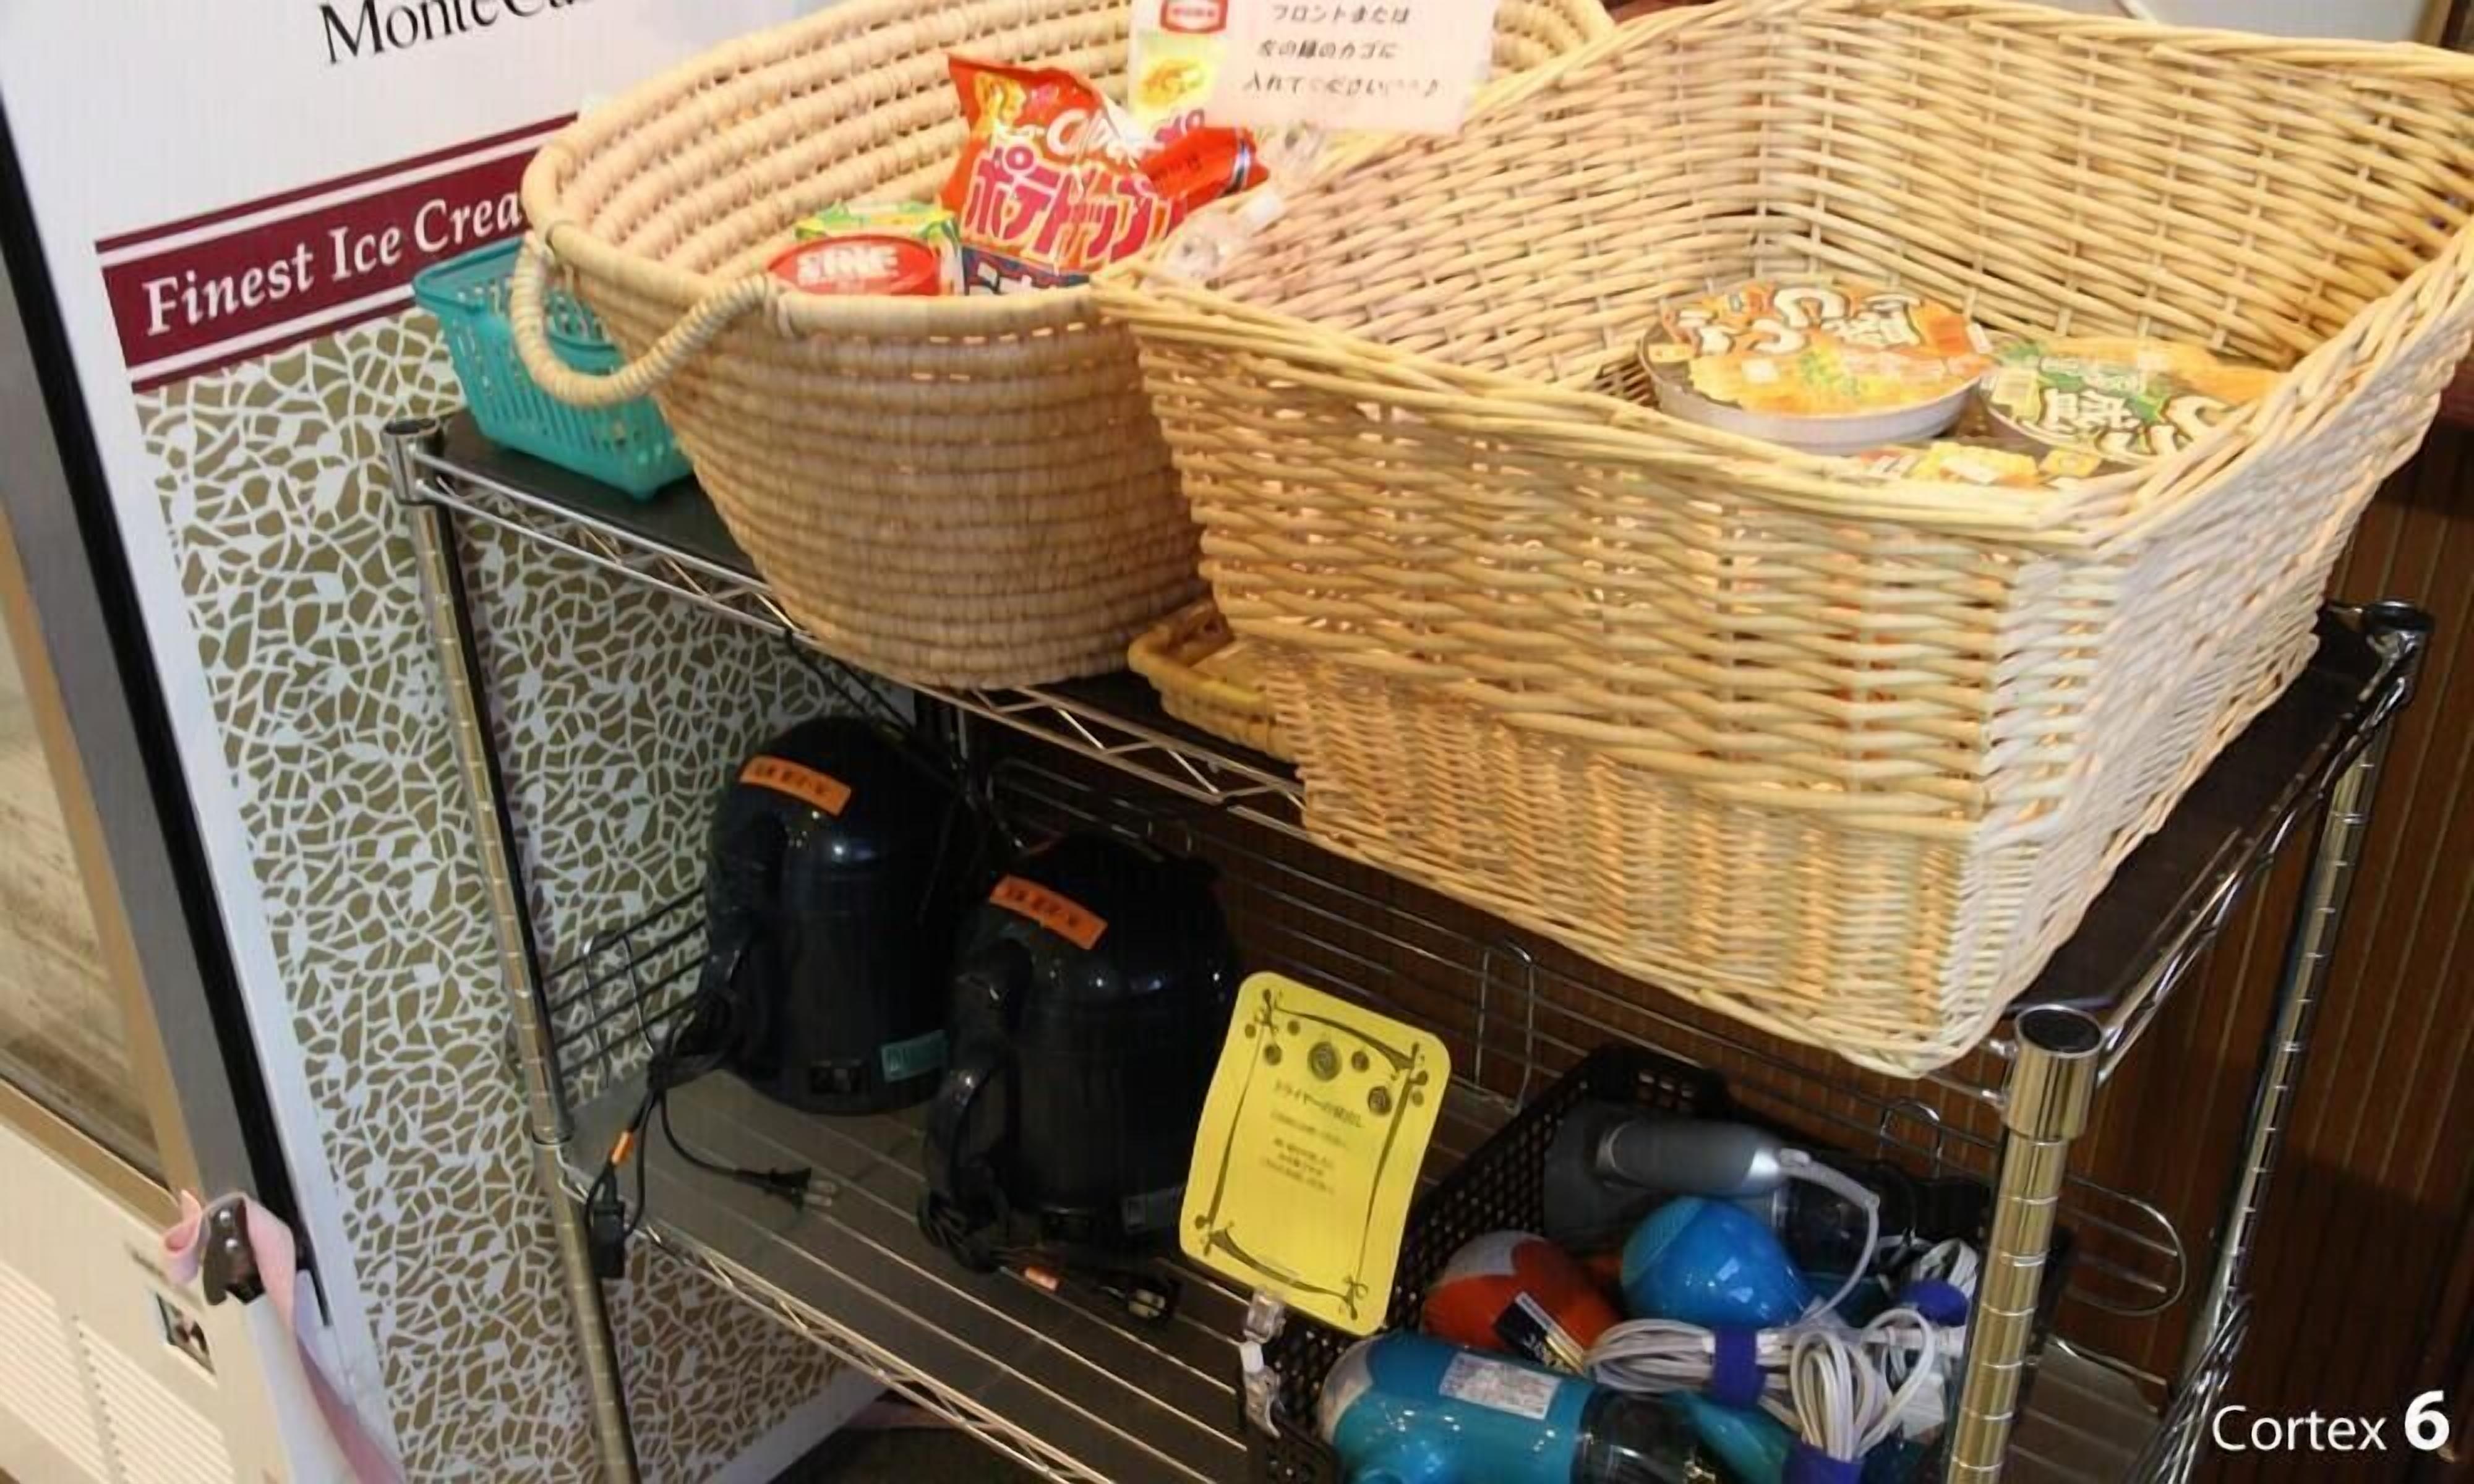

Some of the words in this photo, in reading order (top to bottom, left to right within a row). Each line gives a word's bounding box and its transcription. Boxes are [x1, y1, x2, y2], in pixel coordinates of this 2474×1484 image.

[142, 242, 314, 336] Finest
[328, 226, 402, 282] Ice
[414, 192, 522, 253] Crea
